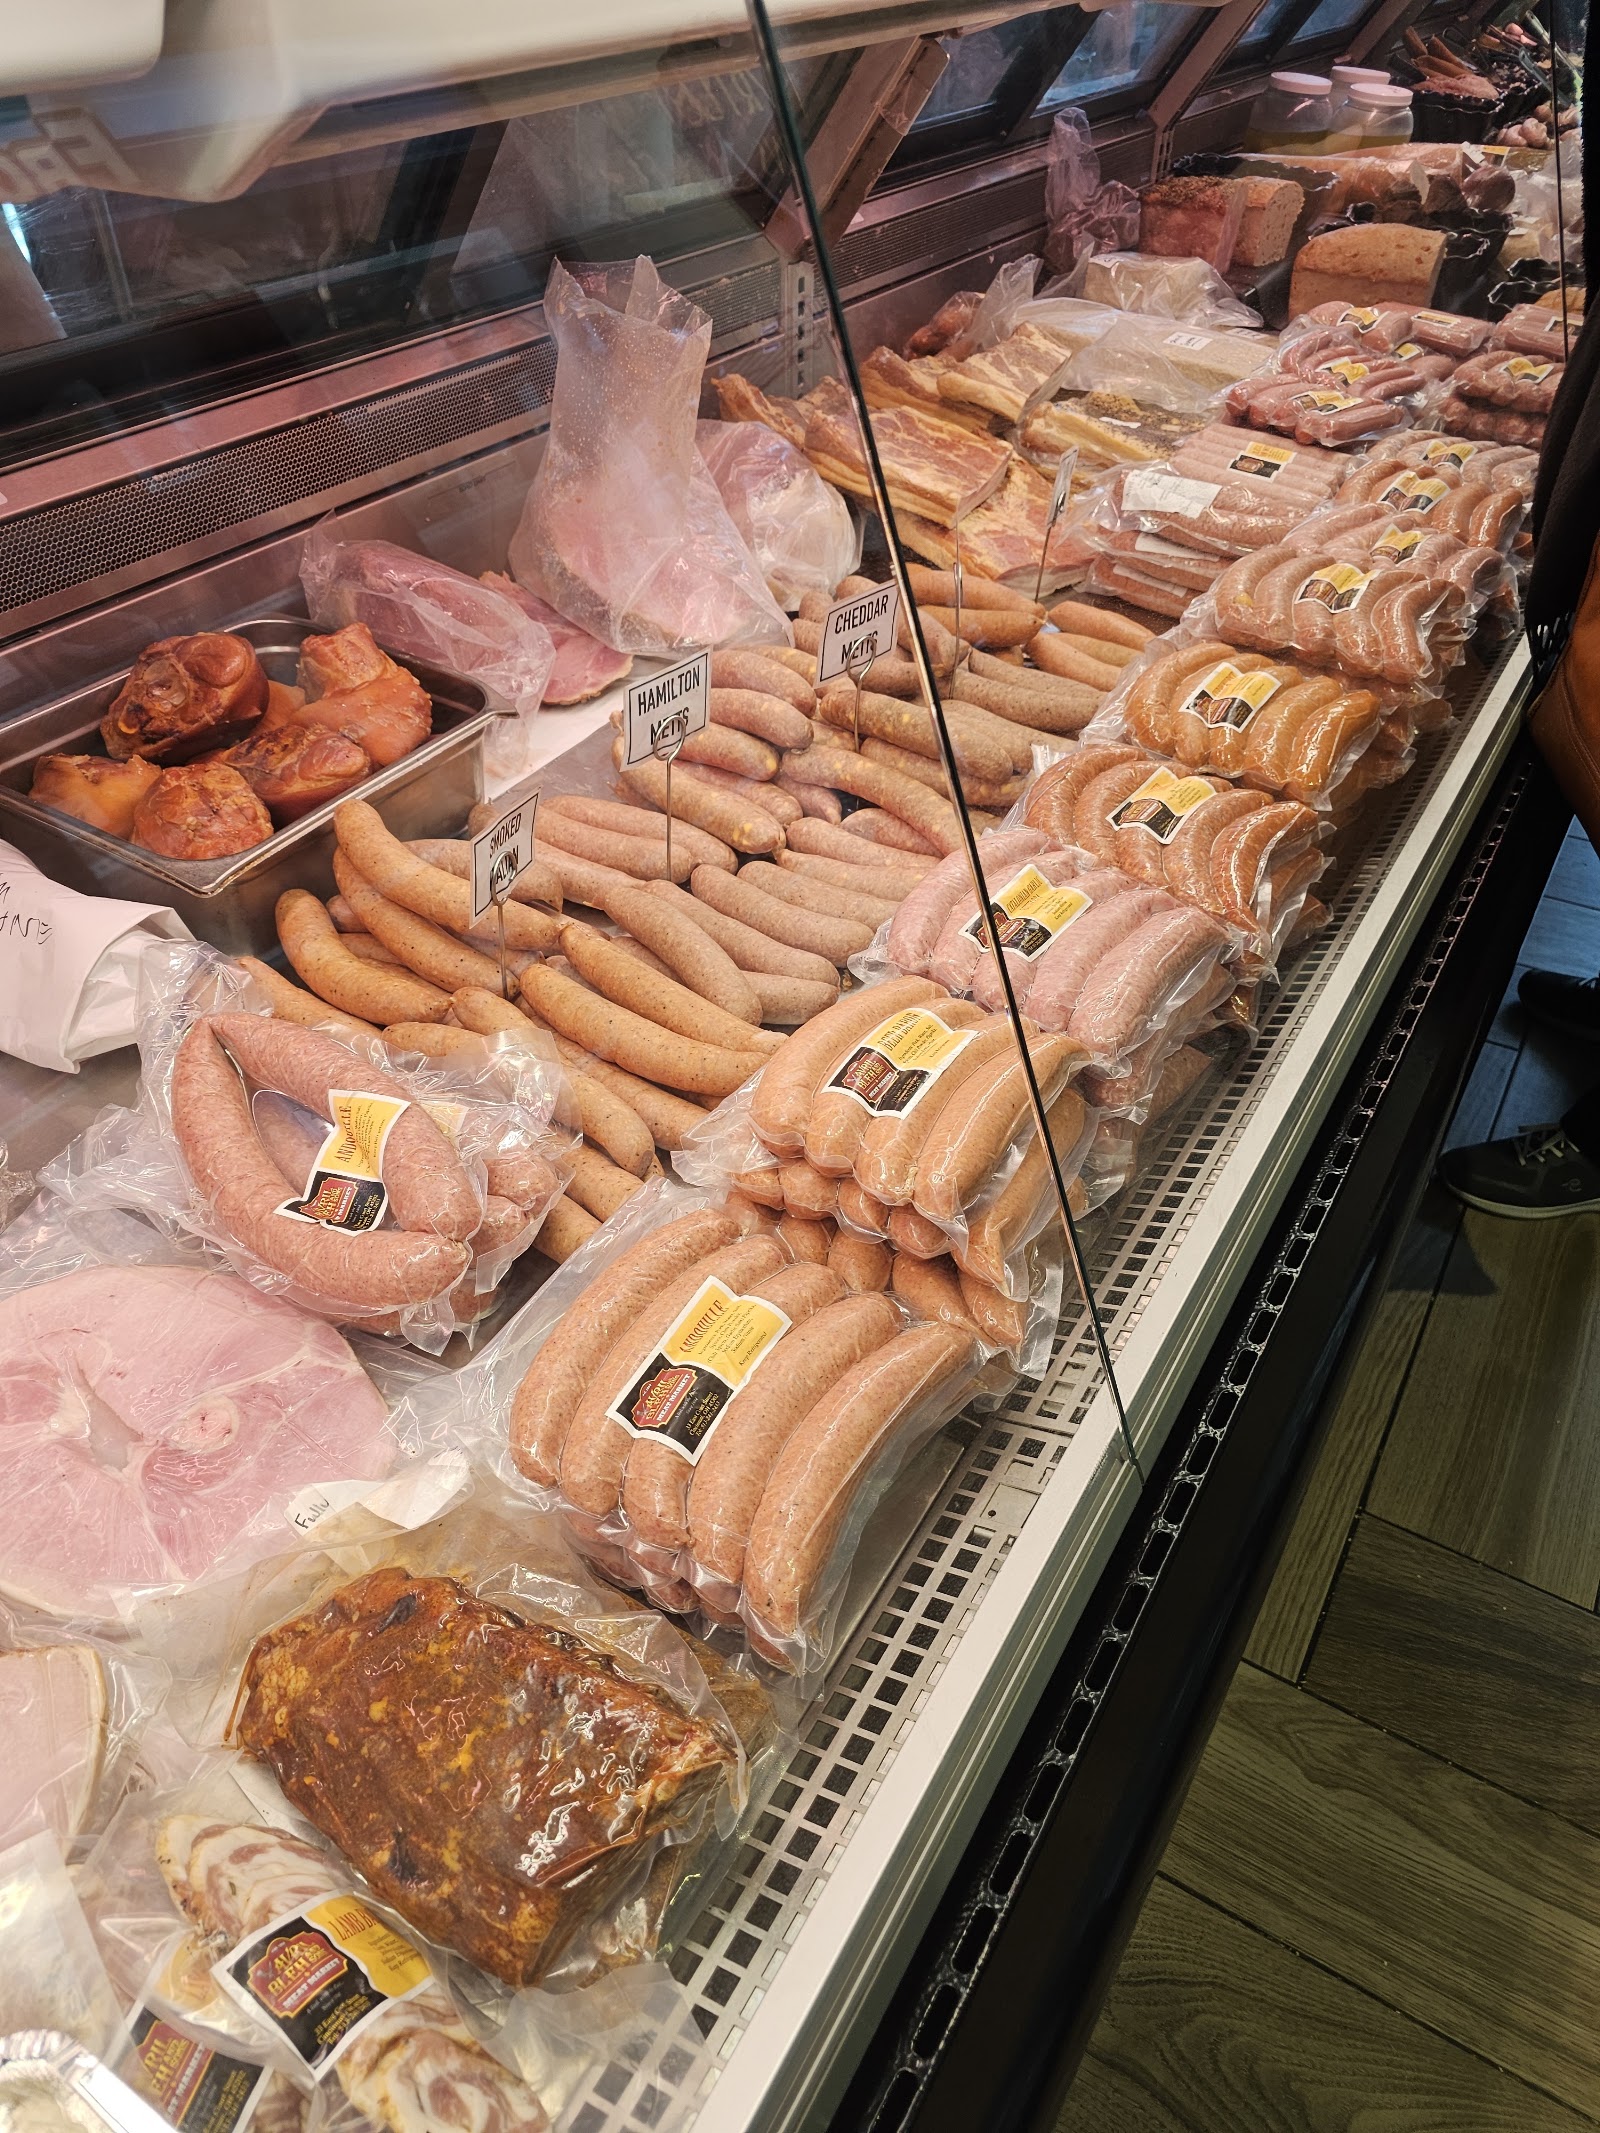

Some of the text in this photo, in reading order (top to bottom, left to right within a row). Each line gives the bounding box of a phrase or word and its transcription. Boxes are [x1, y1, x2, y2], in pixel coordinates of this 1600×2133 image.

[834, 594, 889, 635] CHEDDAR
[841, 630, 879, 664] METTS
[637, 664, 701, 717] HAMILTON
[650, 706, 690, 746] METTS
[489, 812, 523, 859] SMOKED
[489, 844, 520, 893] IALIAN
[854, 1058, 876, 1078] AVRIL
[857, 1070, 878, 1089] BLEH
[334, 1105, 356, 1163] ANDOUILLE
[657, 1374, 691, 1421] MEAT MARKET
[328, 1911, 367, 1941] LAMB
[267, 1956, 311, 1997] BLEH
[282, 1983, 309, 2009] MEAT
[307, 1958, 341, 1986] MARKET
